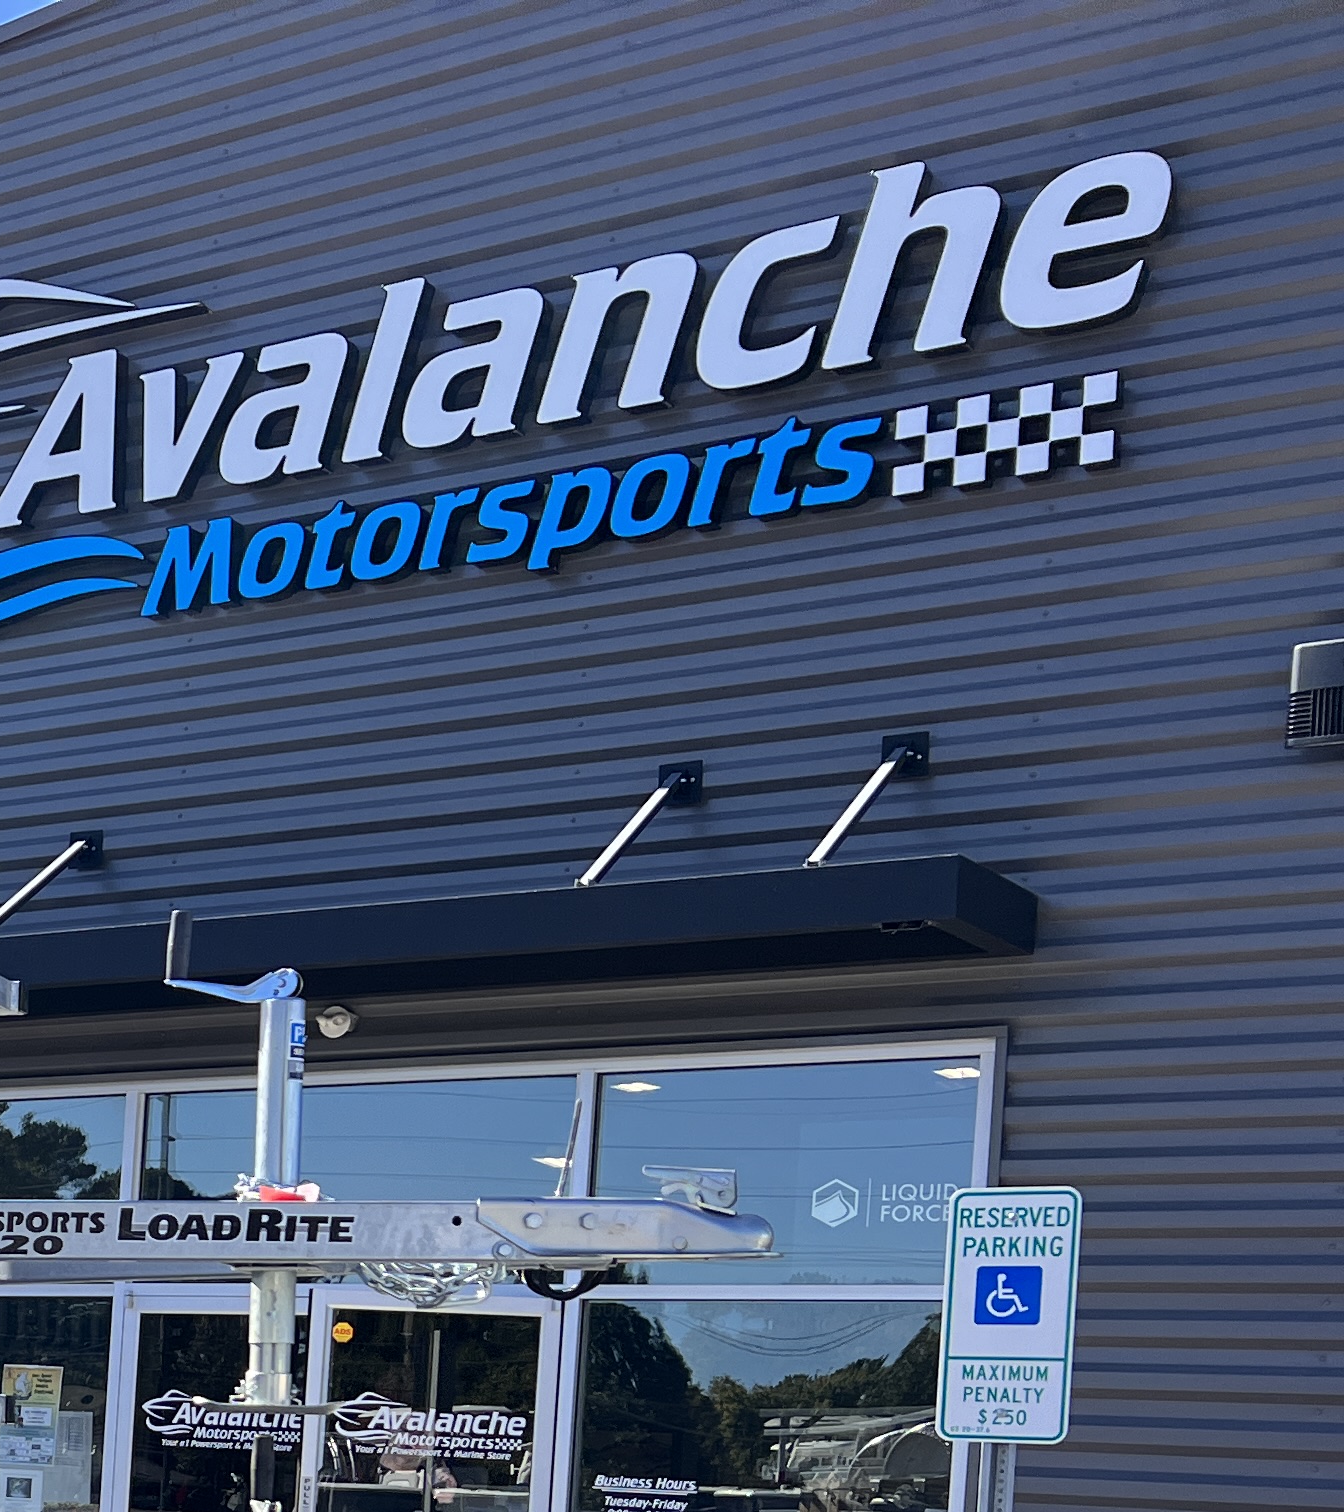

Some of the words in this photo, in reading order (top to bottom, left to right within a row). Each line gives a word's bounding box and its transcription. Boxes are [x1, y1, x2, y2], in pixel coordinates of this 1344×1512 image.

[139, 415, 883, 617] Motorsports
[881, 1183, 958, 1201] LIQUID
[960, 1206, 1070, 1228] RESERVED
[962, 1236, 1064, 1258] PARKING
[961, 1364, 1049, 1382] MAXIMUM
[962, 1386, 1045, 1404] PENALTY
[367, 1405, 527, 1436] Avalanche
[394, 1432, 495, 1450] Motorsports
[454, 1449, 485, 1459] Marine
[486, 1451, 512, 1461] Store
[302, 1478, 311, 1505] PULL
[594, 1474, 653, 1489] Business
[655, 1477, 697, 1491] Hours
[604, 1496, 689, 1512] Tuesday-Friday
